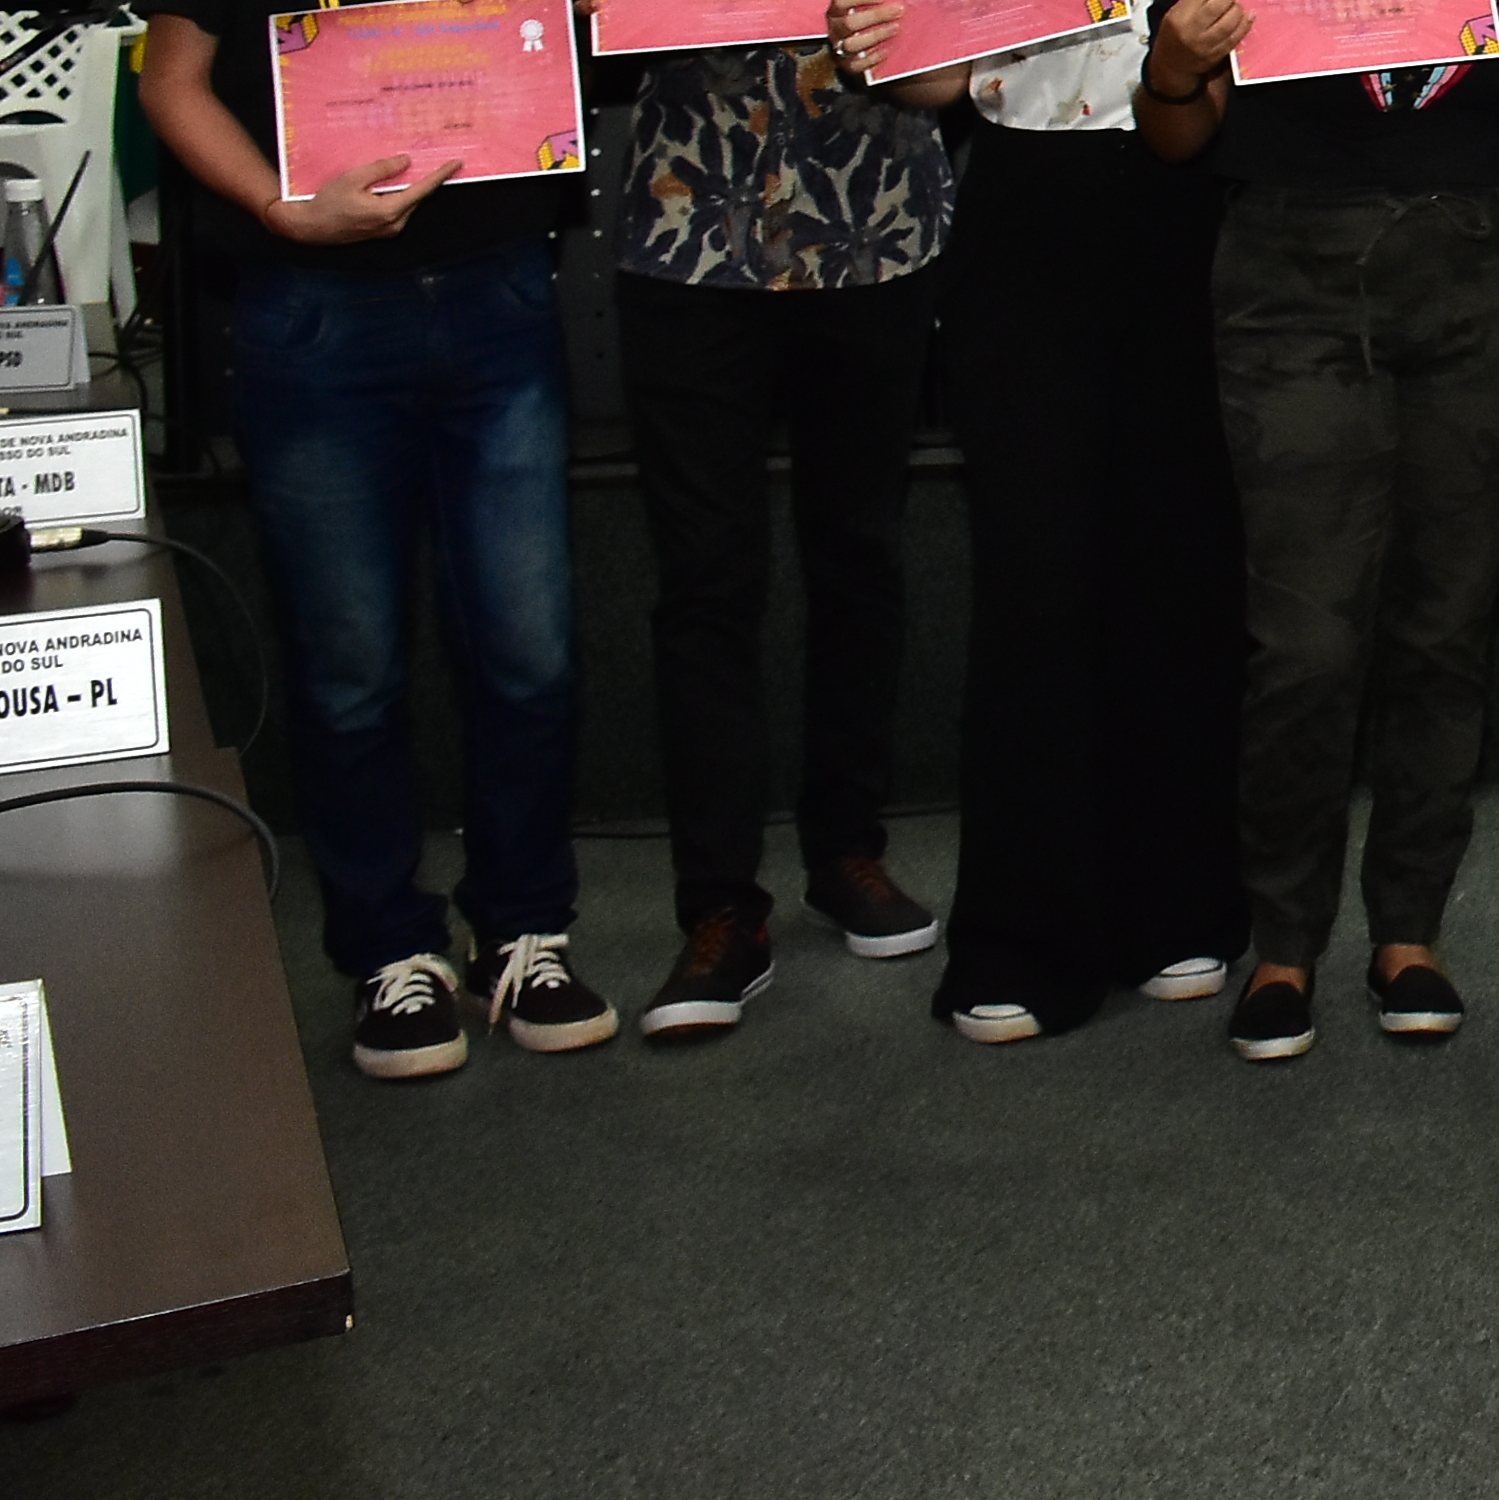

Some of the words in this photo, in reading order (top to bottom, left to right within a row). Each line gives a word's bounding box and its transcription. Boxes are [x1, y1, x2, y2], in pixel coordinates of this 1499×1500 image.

[20, 434, 53, 447] NOVA
[57, 428, 129, 444] ANDRADINA
[26, 447, 43, 458] DO
[48, 445, 71, 457] SUL
[34, 471, 76, 495] MDB
[45, 628, 143, 651] ANDRADINA
[2, 659, 25, 674] DO
[31, 655, 63, 671] SUL
[91, 677, 118, 708] PL
